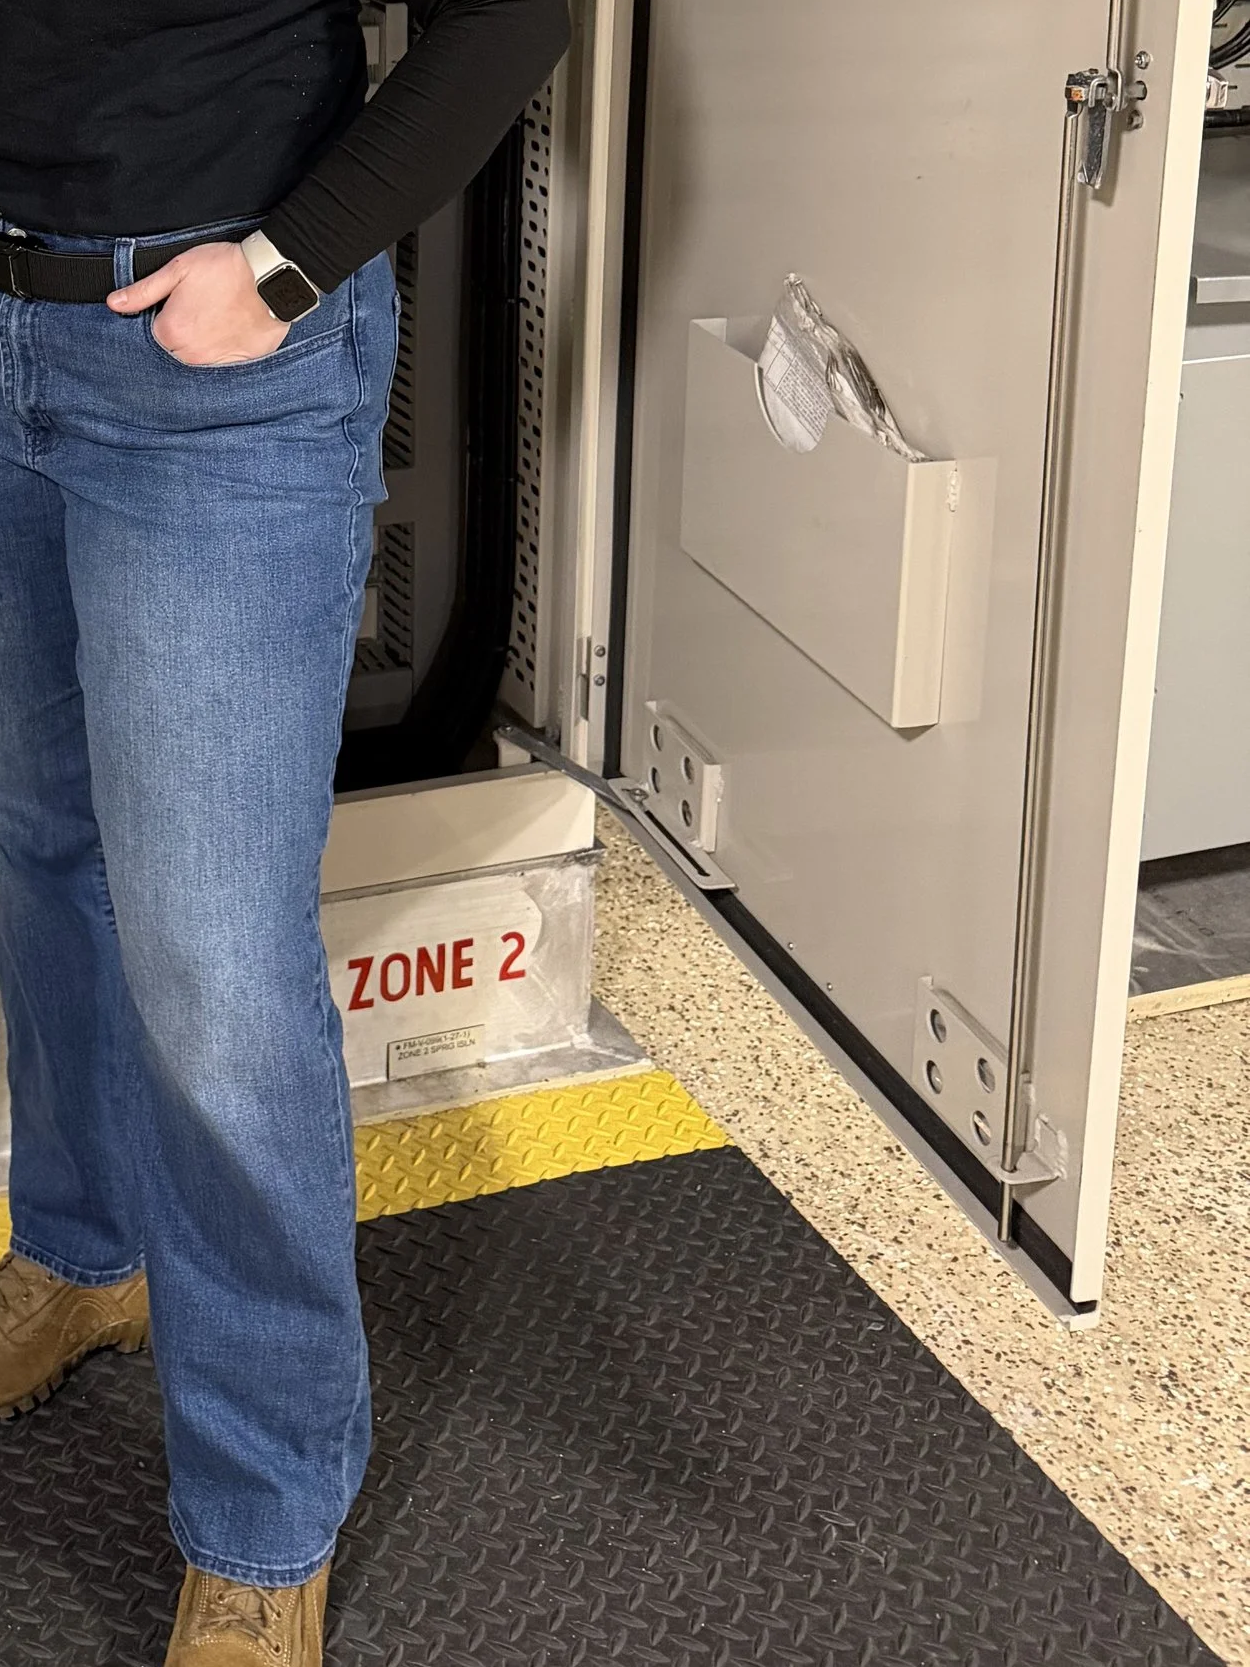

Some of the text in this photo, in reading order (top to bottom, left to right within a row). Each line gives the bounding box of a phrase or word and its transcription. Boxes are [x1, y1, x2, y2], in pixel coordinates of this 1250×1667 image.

[347, 931, 526, 1011] ZONE 2
[398, 1049, 421, 1060] ZONE
[430, 1042, 455, 1054] SPRG
[457, 1038, 476, 1048] ISLN
